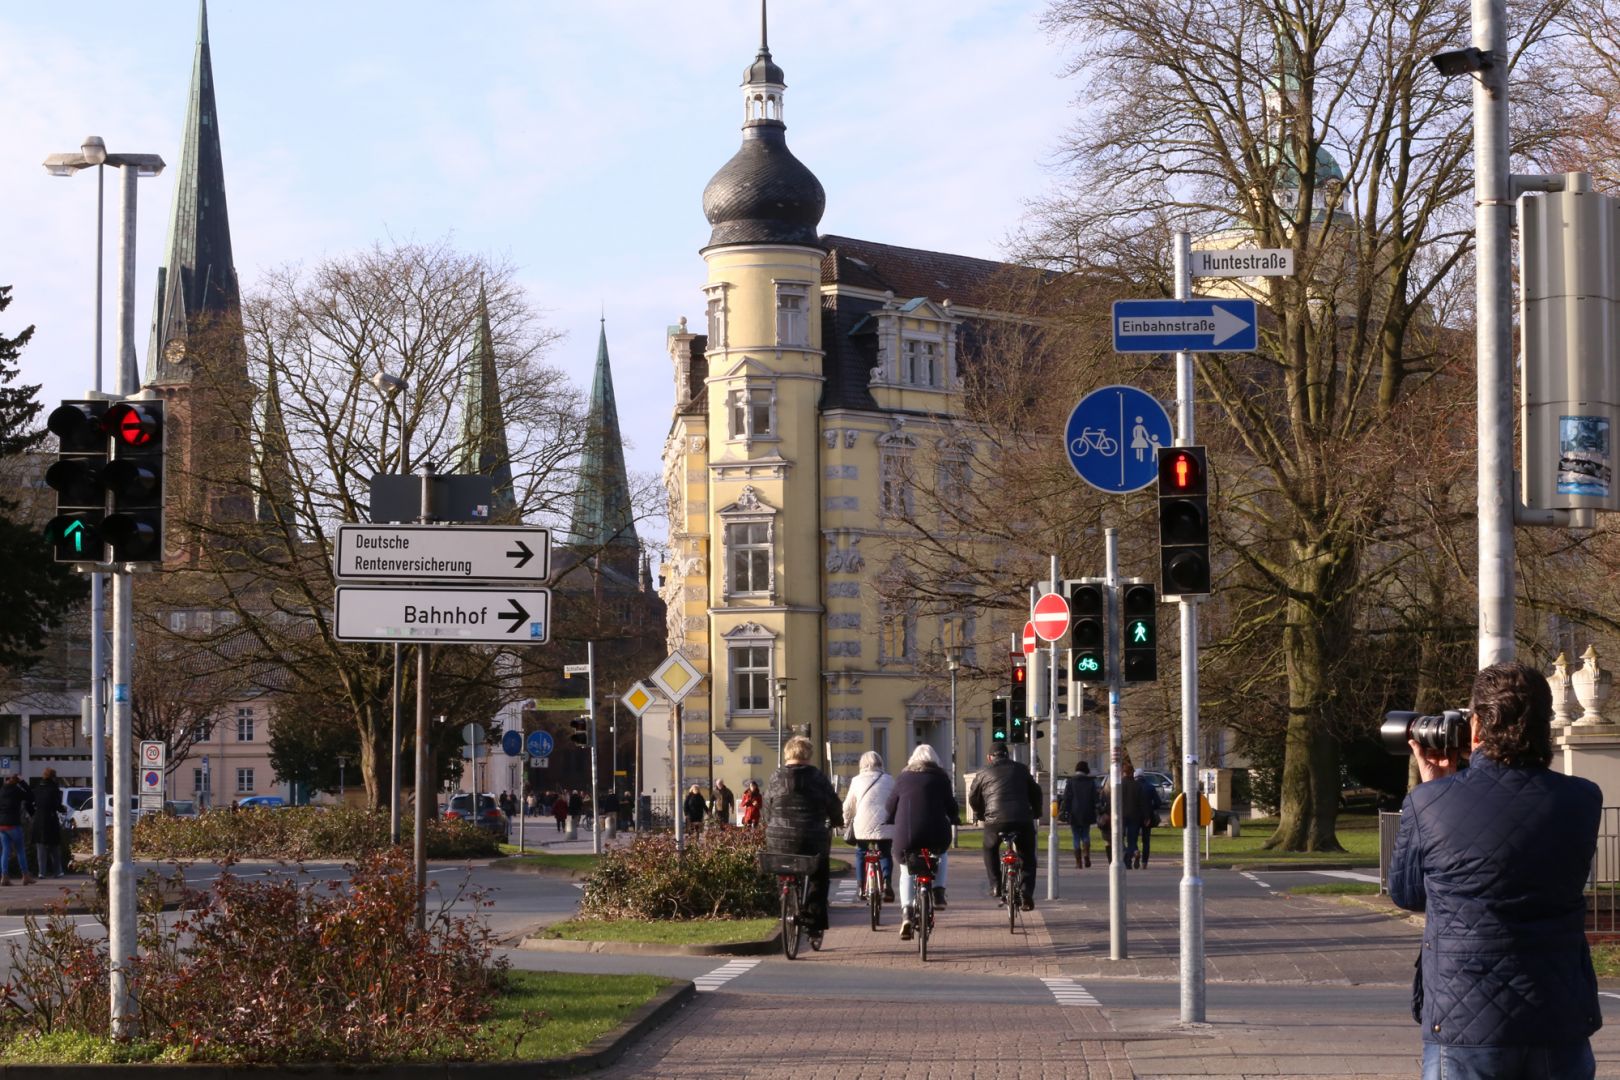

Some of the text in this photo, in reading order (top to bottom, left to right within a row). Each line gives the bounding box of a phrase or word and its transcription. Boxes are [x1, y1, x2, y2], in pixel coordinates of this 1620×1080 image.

[1202, 253, 1286, 270] Huntestraße
[1122, 320, 1215, 333] Einbahnstraße
[356, 534, 410, 549] Deutsche
[355, 556, 472, 575] Rentenversicherung
[404, 605, 487, 624] Bahnhof
